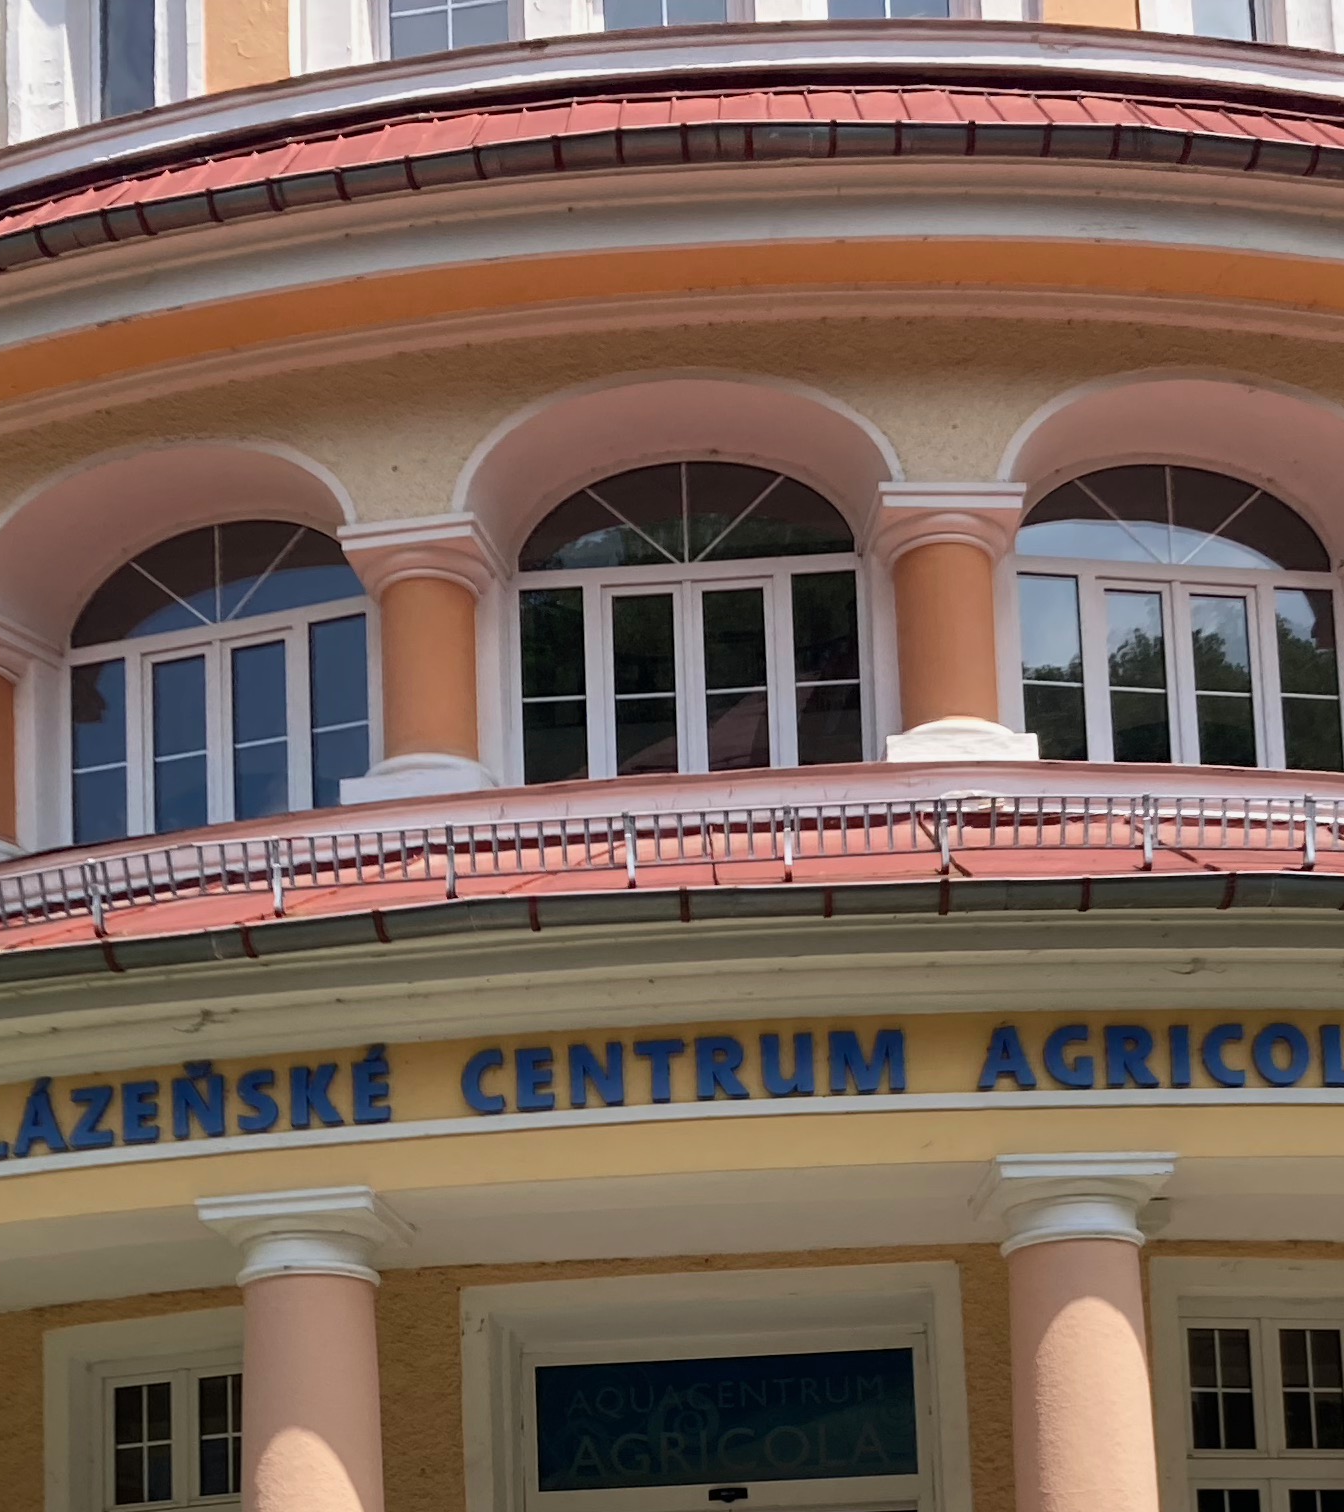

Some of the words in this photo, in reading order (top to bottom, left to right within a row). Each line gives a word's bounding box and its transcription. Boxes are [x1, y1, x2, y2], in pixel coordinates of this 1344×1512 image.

[460, 1028, 906, 1115] CENTRUM
[566, 1373, 886, 1420] AQUACENTRUM
[568, 1423, 890, 1478] AGRICOLA
